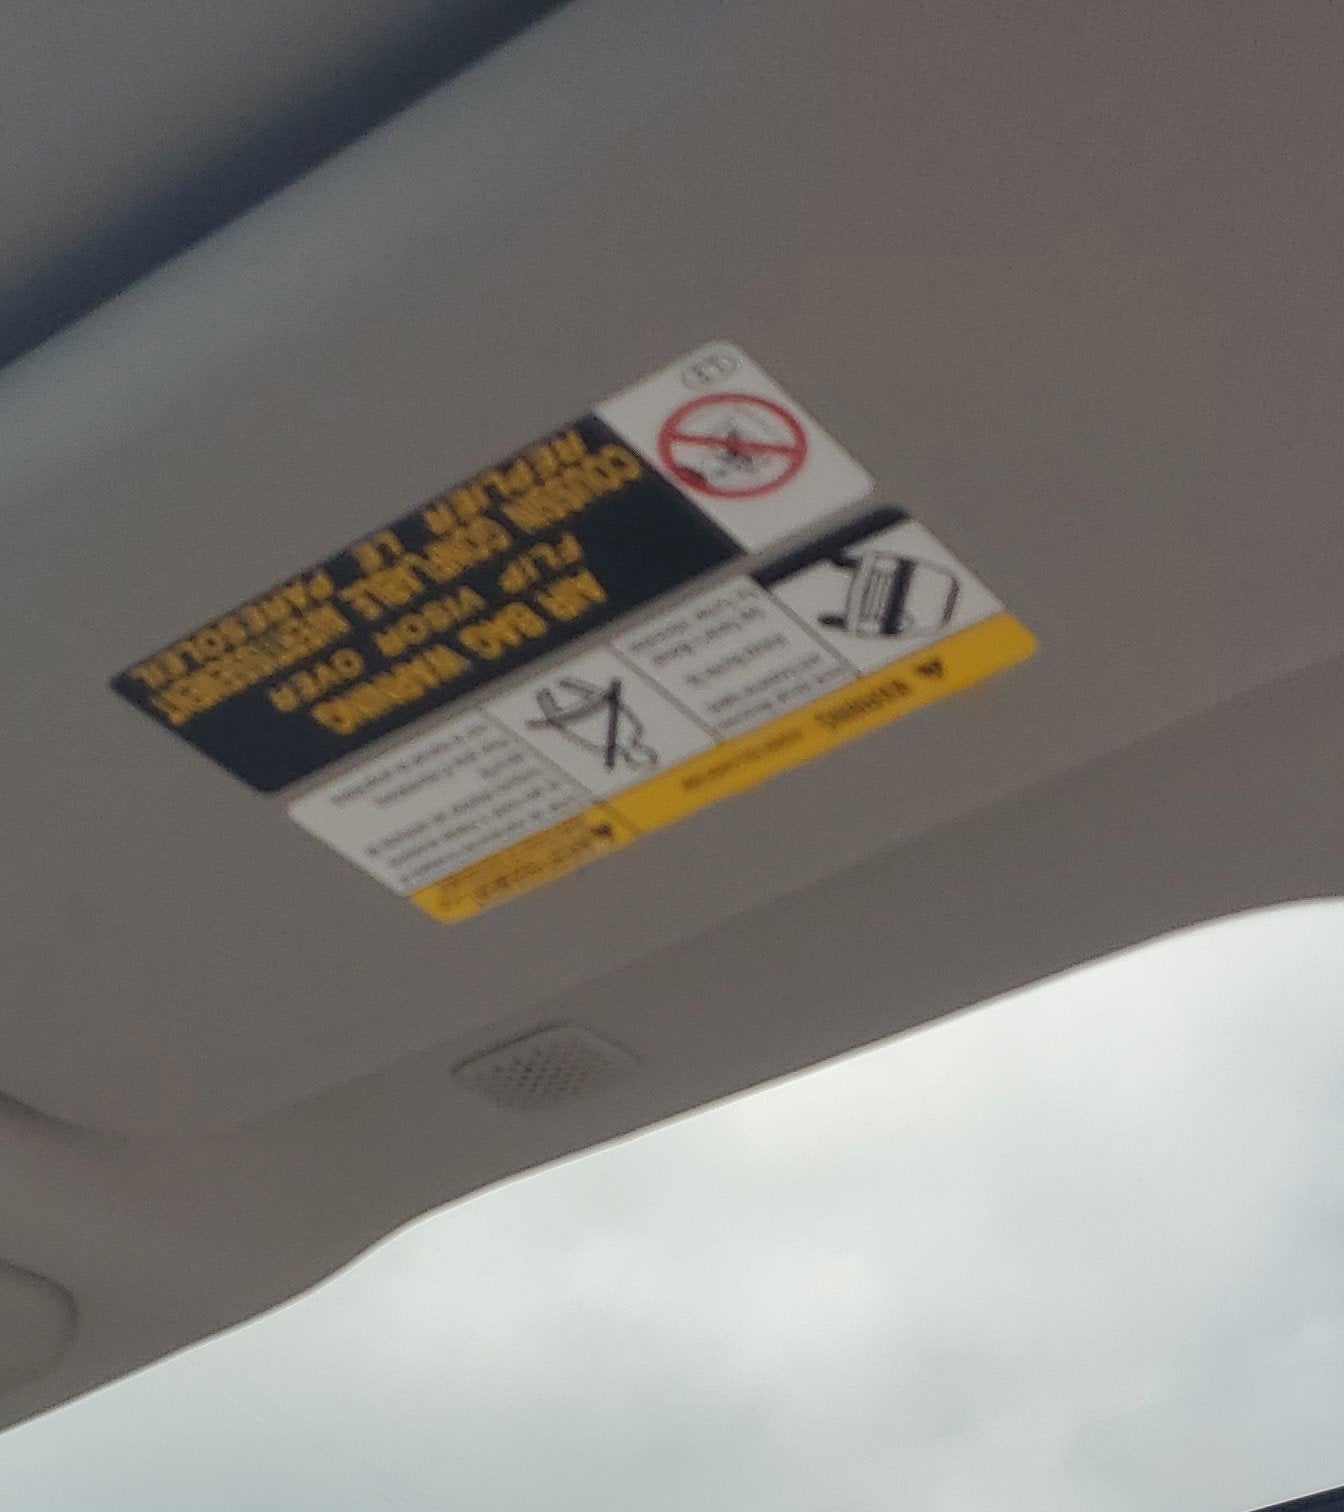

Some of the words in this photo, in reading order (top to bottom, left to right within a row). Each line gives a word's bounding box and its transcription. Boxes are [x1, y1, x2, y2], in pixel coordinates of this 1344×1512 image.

[350, 527, 405, 575] LE
[497, 530, 584, 596] FLIP
[372, 585, 485, 659] VISOR
[534, 567, 608, 622] AIR
[456, 602, 548, 662] BAG
[267, 647, 364, 713] OVER
[309, 643, 471, 736] WARNING
